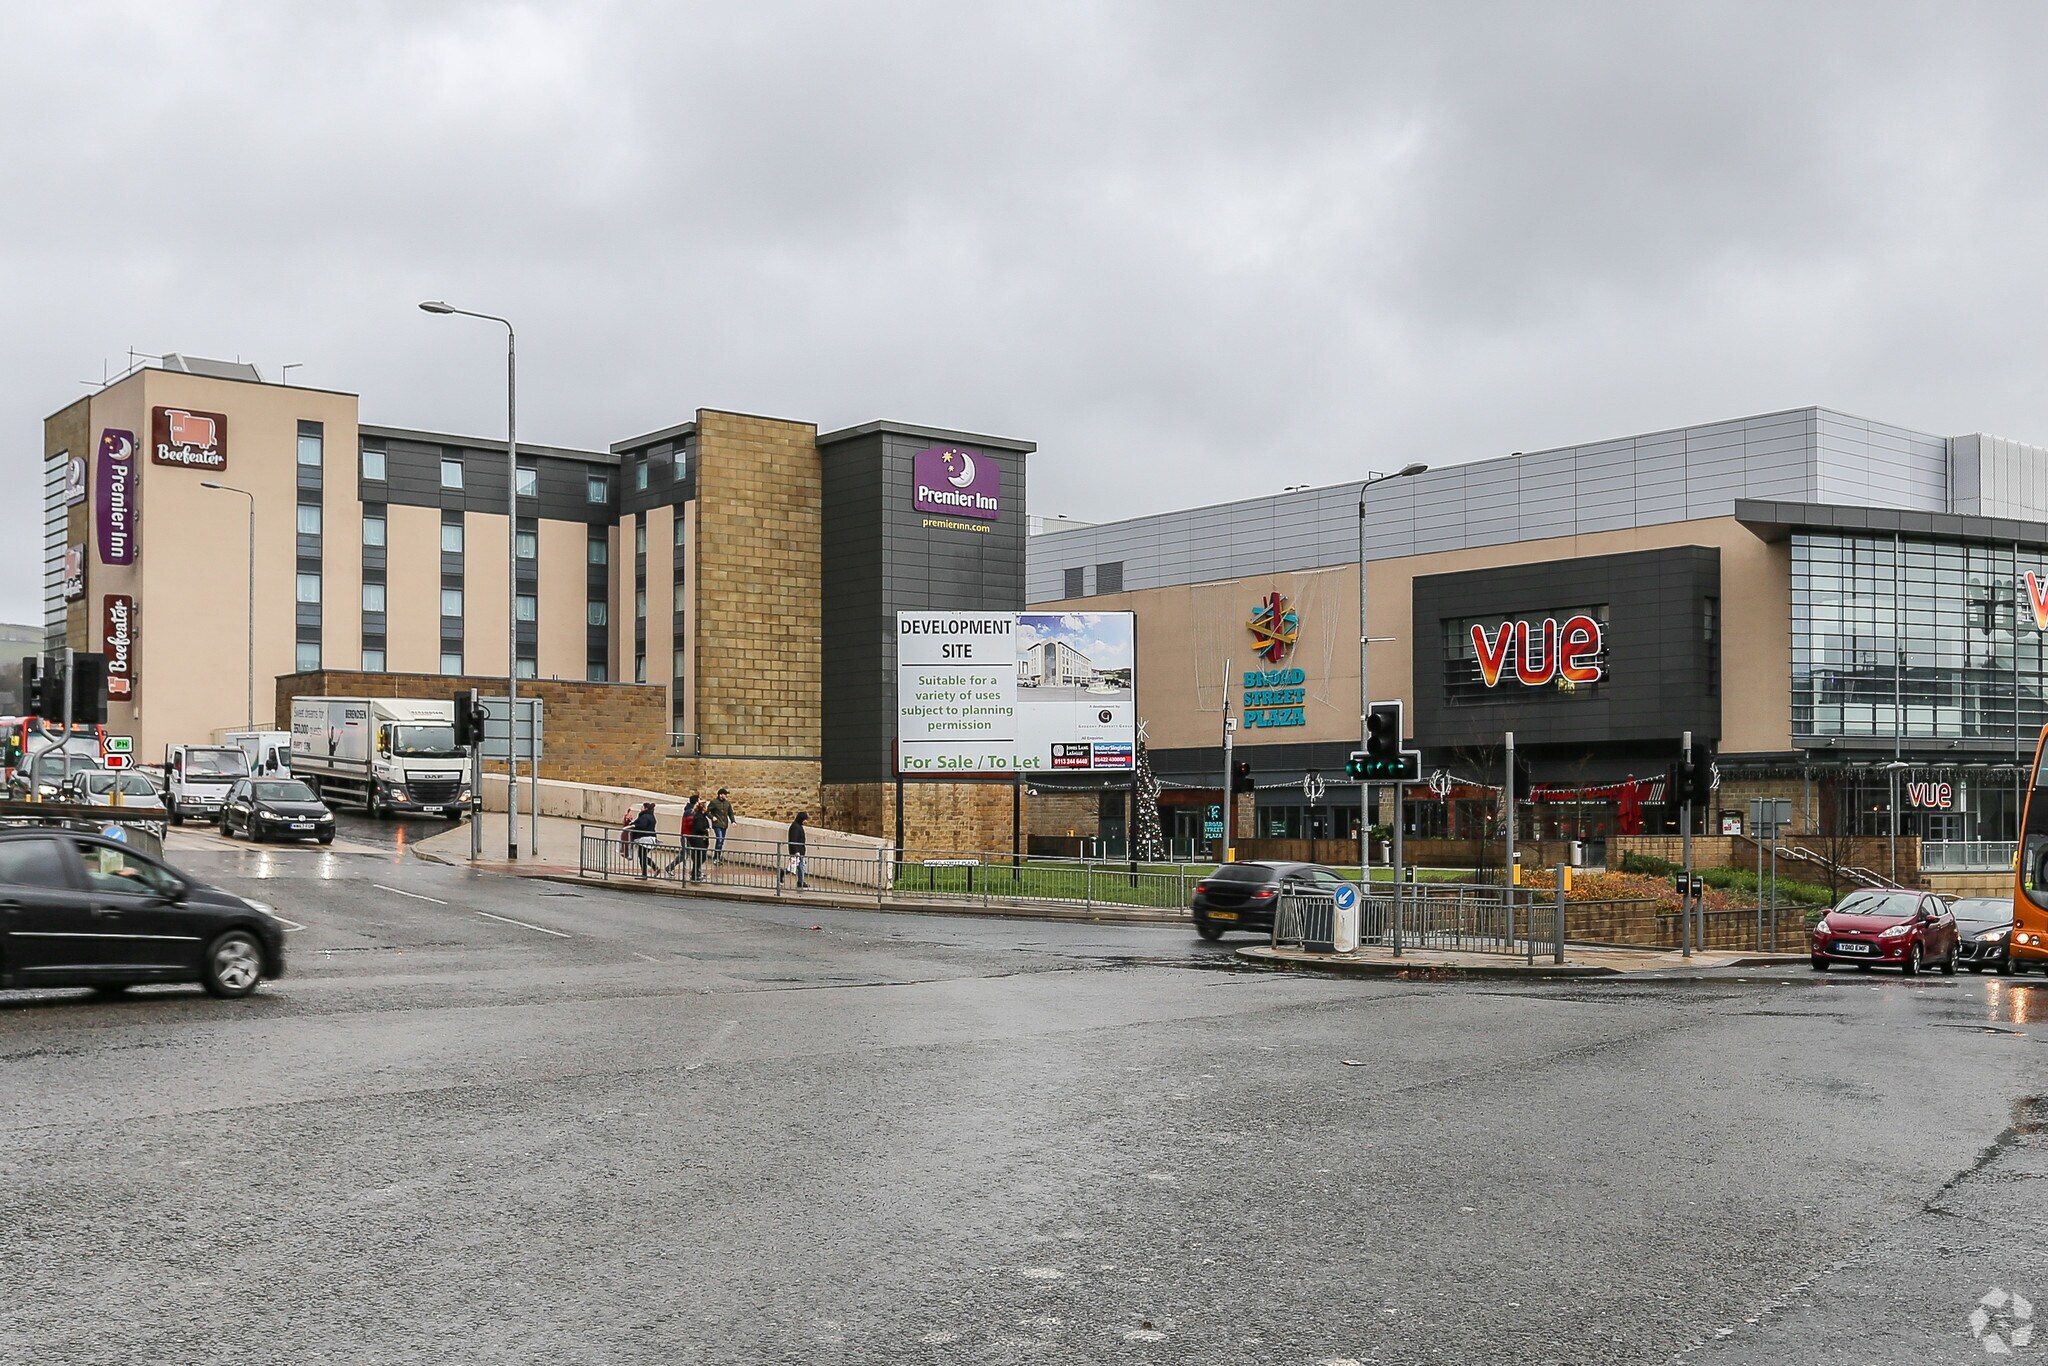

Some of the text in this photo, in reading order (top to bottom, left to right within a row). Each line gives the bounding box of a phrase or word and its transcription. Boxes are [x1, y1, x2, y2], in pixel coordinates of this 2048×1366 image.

[157, 444, 224, 465] Beefeater
[918, 485, 998, 510] Premier Inn
[111, 465, 128, 557] Premier Inn
[922, 518, 990, 533] premierinn.com
[901, 620, 1012, 635] DEVELOPMENT
[107, 599, 130, 673] Beefeater
[942, 643, 972, 658] SITE
[918, 675, 997, 686] Suitable for a
[1244, 668, 1306, 688] BROAD
[915, 690, 1001, 702] variety of uses
[1244, 688, 1306, 706] STREET
[901, 704, 1014, 718] subject to planning
[1244, 707, 1306, 729] PLAZA
[928, 719, 992, 732] permission
[903, 754, 1040, 770] For Sale / To Let
